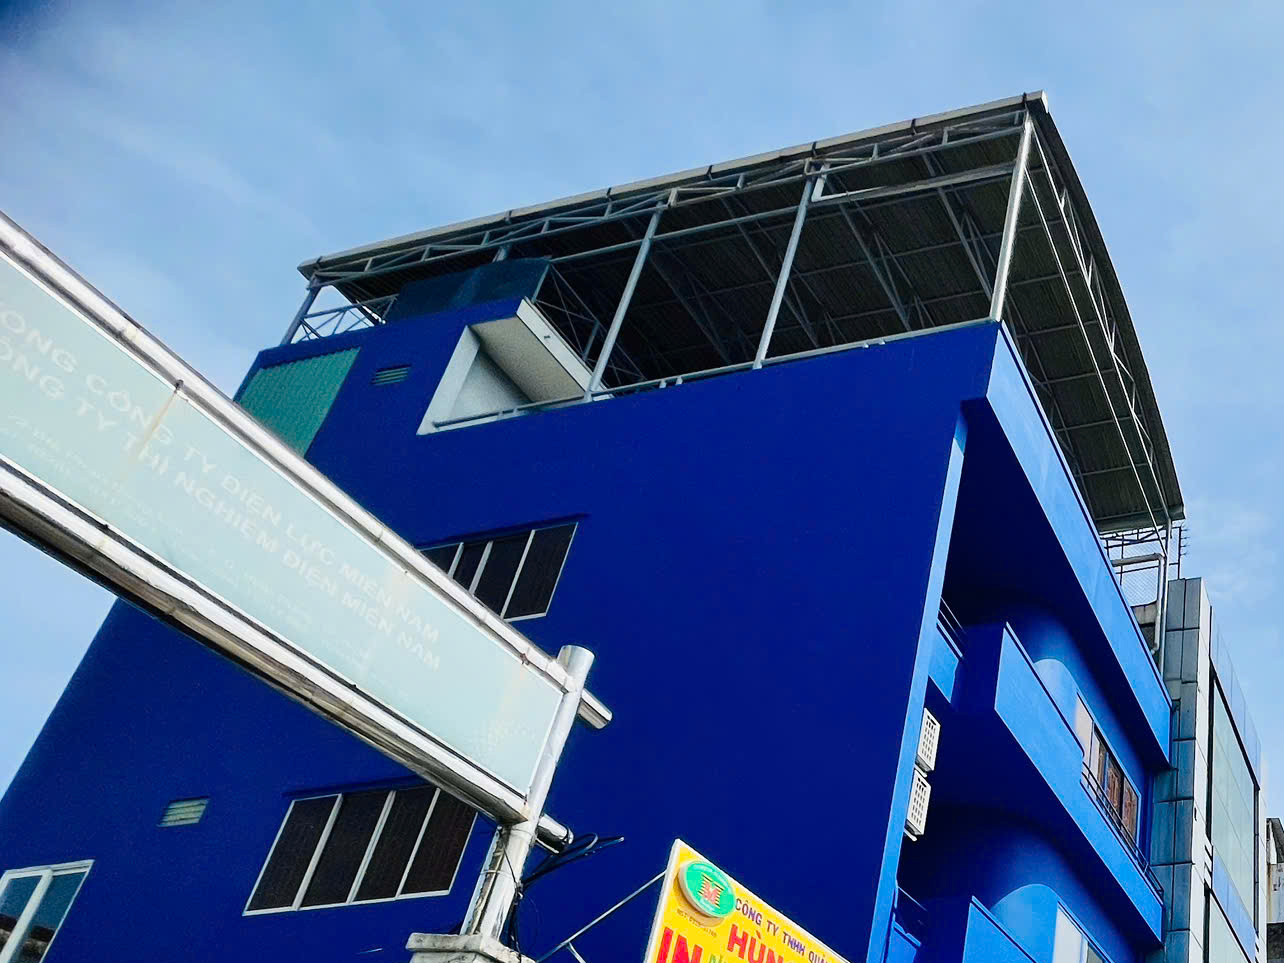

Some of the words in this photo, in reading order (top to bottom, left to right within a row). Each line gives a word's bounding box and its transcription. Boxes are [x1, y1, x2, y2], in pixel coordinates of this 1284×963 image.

[736, 897, 762, 925] CÔNG
[766, 919, 779, 936] TY
[782, 931, 806, 956] TNHH
